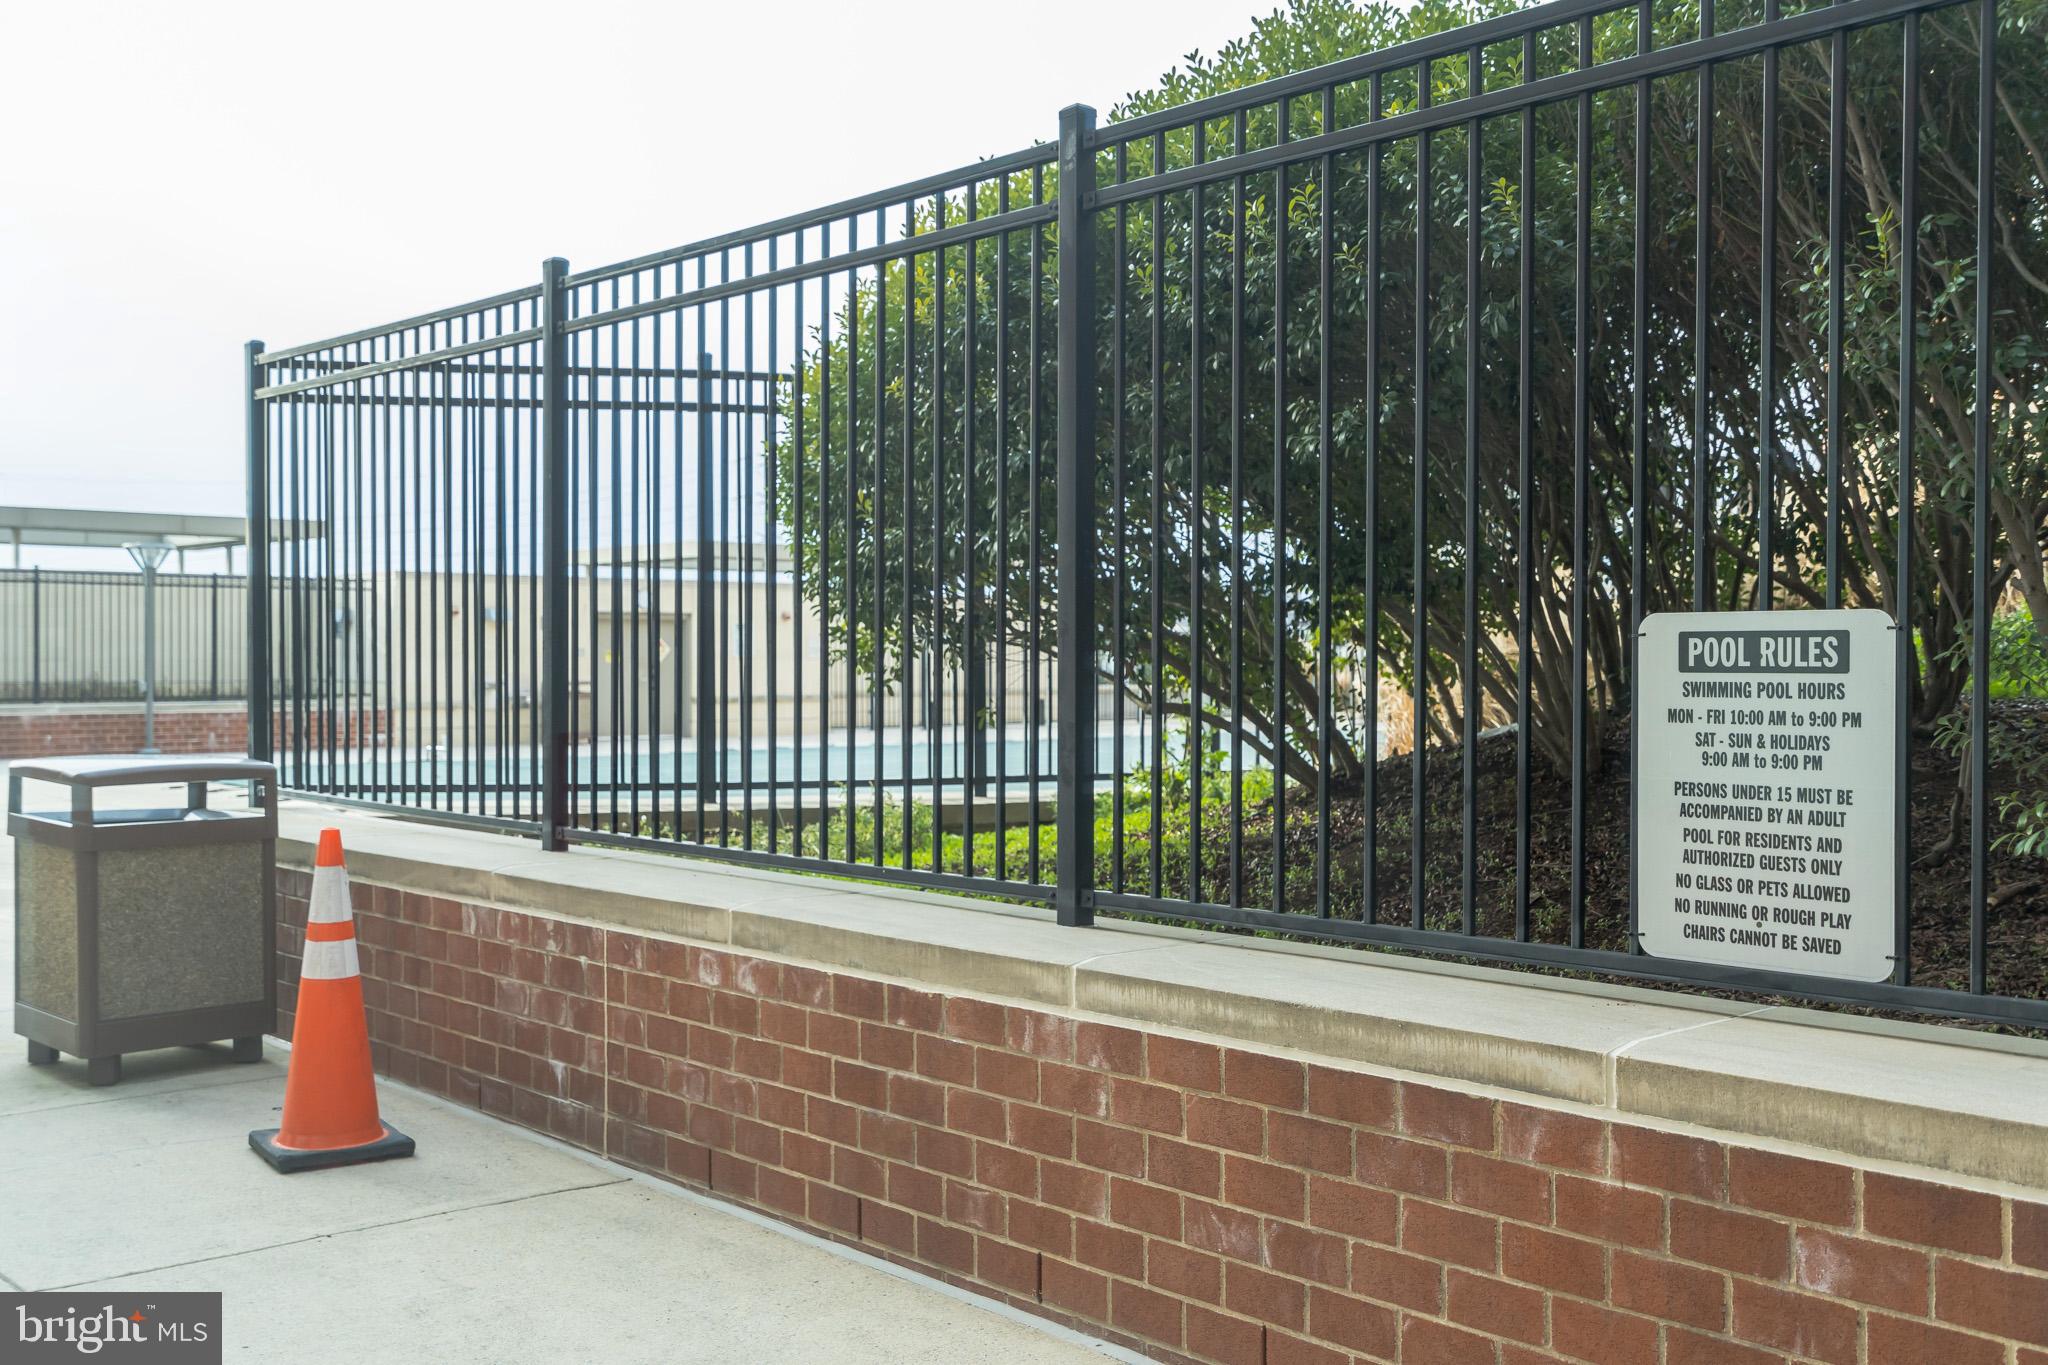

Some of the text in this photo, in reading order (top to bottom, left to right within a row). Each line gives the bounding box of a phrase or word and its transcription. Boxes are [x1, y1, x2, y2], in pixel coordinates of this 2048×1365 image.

[1688, 636, 1838, 668] POOL RULES
[1682, 681, 1845, 700] SWIMMING POOL HOURS
[1668, 709, 1693, 724] MON
[1707, 709, 1725, 724] FRI
[1730, 710, 1764, 725] 10:00
[1768, 711, 1787, 726] AM
[1791, 711, 1804, 727] to
[1809, 712, 1837, 727] 9:00
[1842, 712, 1862, 728] PM
[1695, 732, 1716, 747] SAT
[1728, 733, 1751, 749] SUN
[1757, 734, 1765, 749] &
[1771, 735, 1830, 751] HOLIDAYS
[1702, 752, 1822, 771] 9:00 AM to 9:00 PM
[1674, 781, 1853, 805] PERSONS UNDER 15 MUST BE
[1680, 803, 1846, 827] ACCOMPANIED BY AN ADULT
[1683, 828, 1842, 854] POOL FOR RESIDENTS AND
[1683, 849, 1842, 876] AUTHORIZED GUESTS ONLY
[1676, 873, 1850, 903] NO GLASS OR PETS ALLOWED
[1675, 898, 1852, 930] NO RUNNING OR ROUGH PLAY
[1683, 924, 1841, 955] CHAIRS CANNOT BE SAVED
